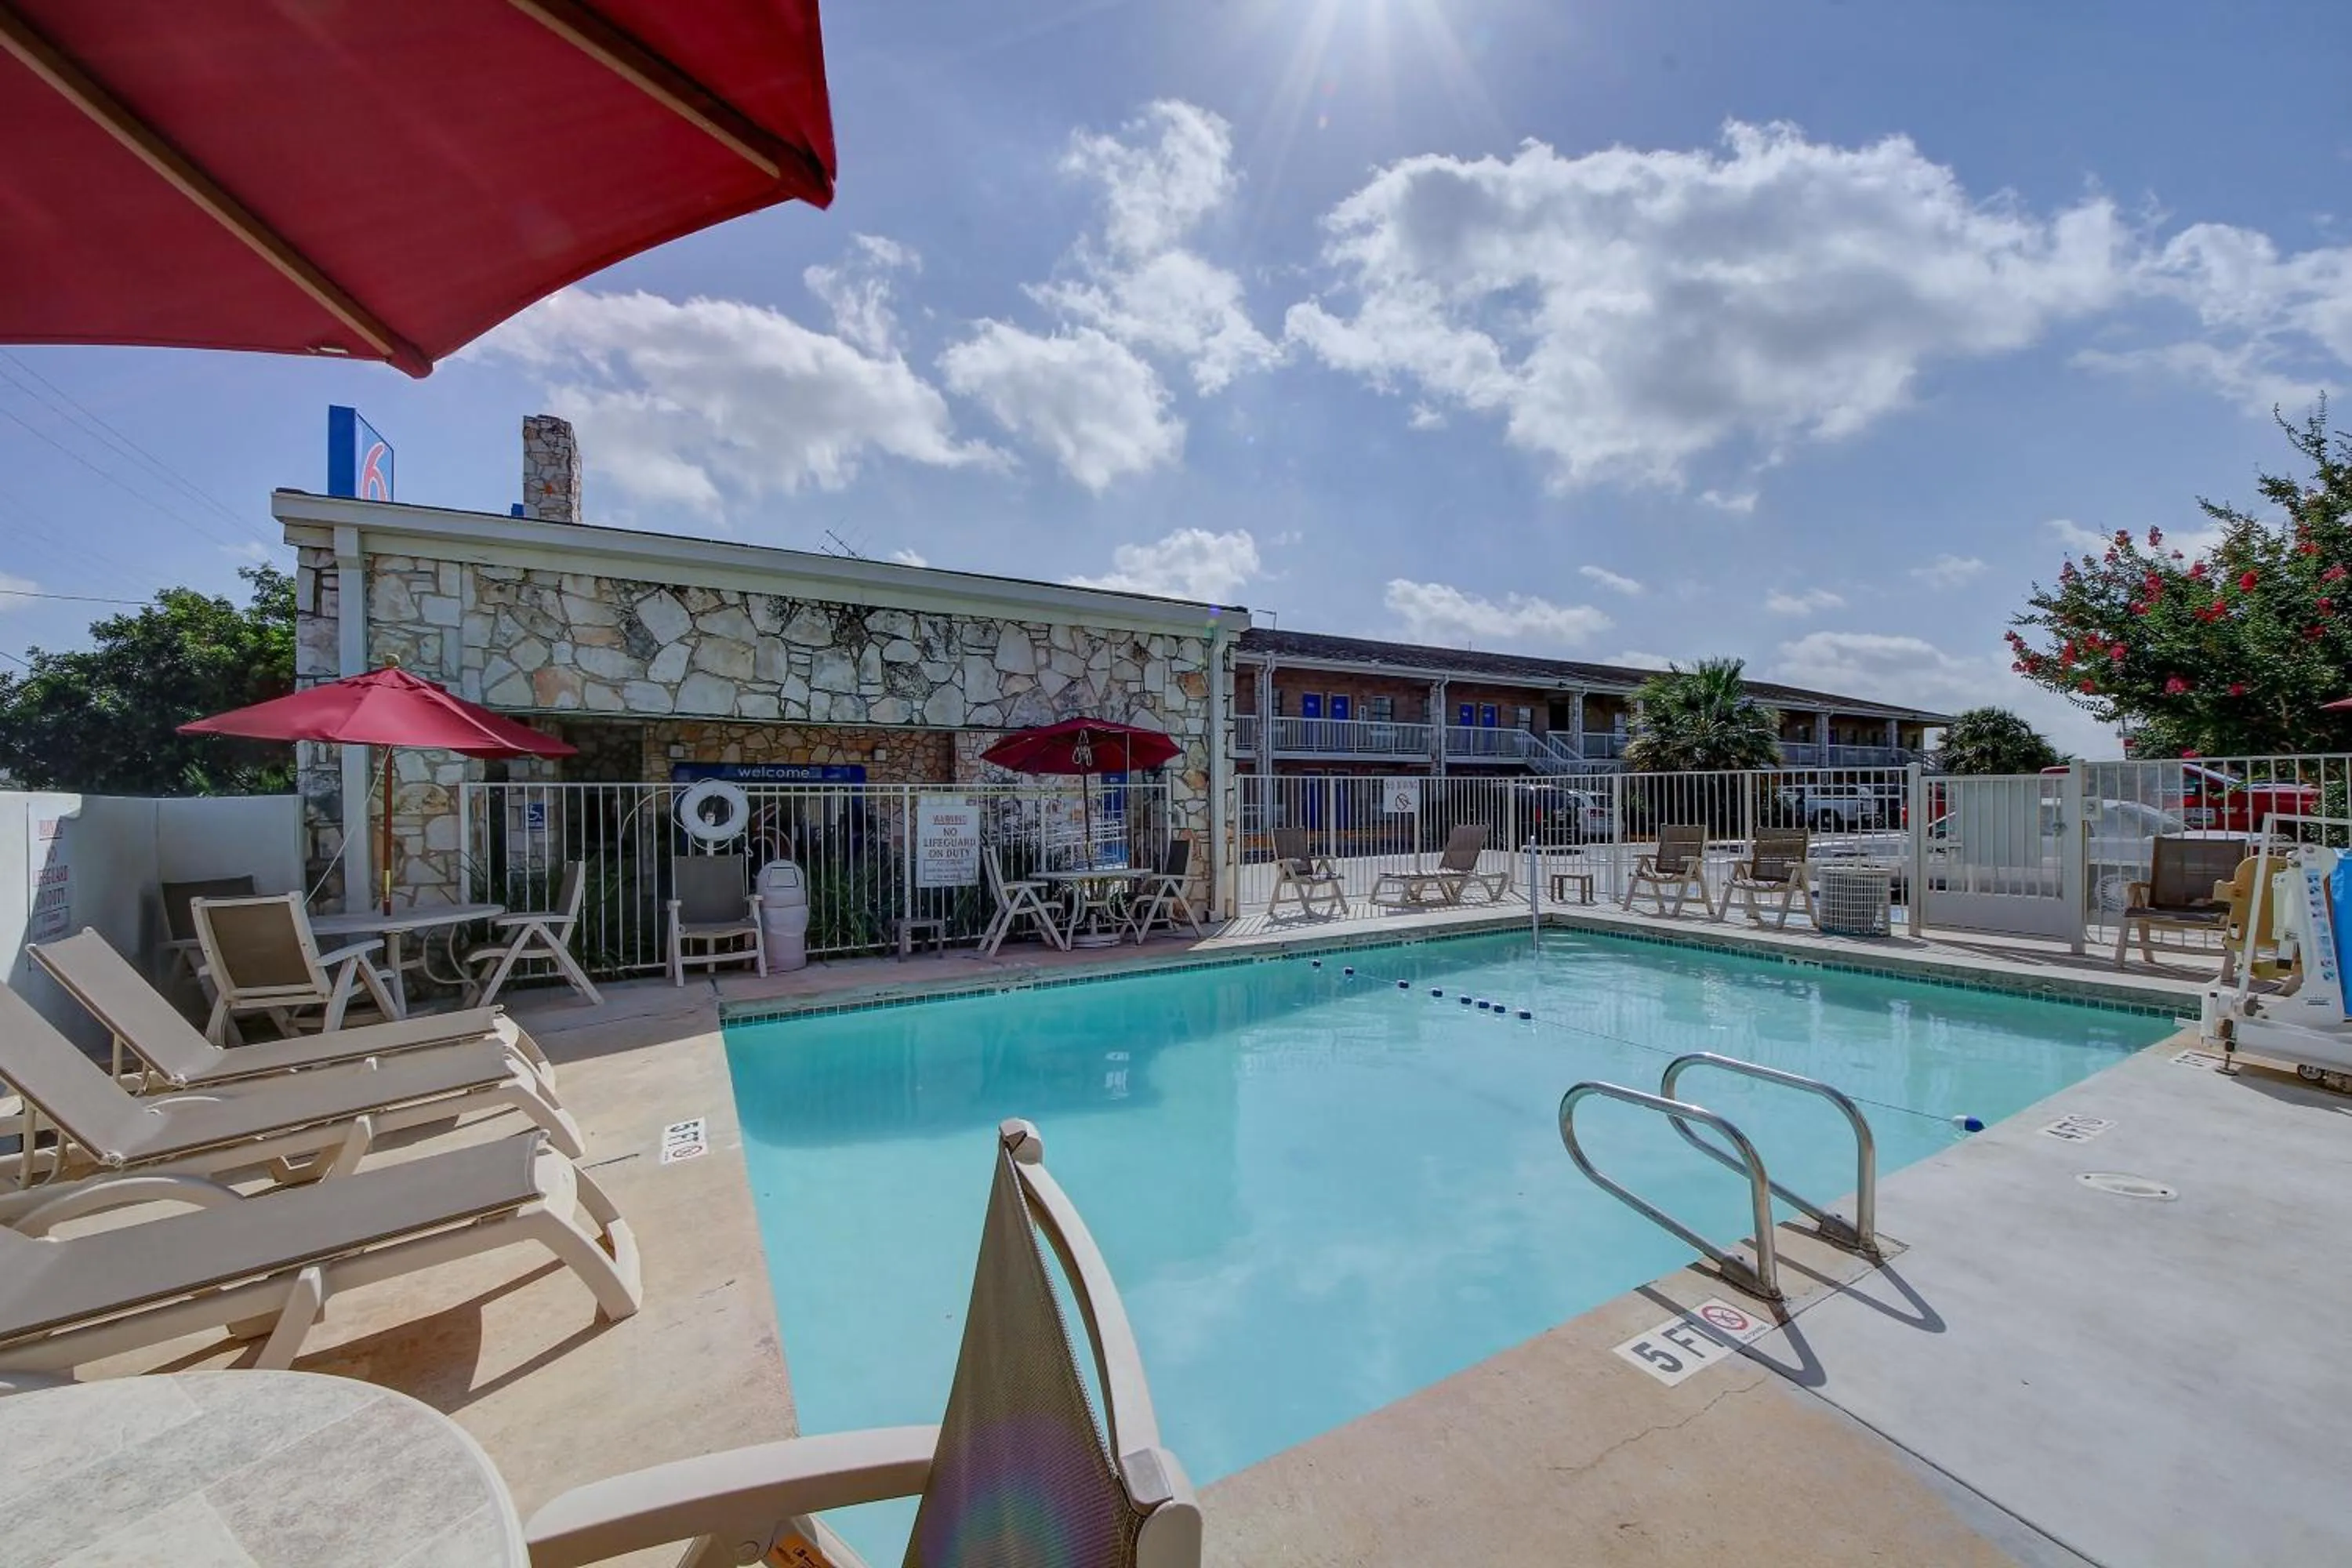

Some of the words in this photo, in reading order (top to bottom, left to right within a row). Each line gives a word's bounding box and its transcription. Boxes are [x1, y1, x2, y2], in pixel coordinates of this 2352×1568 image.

[738, 766, 810, 779] welcome
[943, 827, 957, 837] NO
[927, 848, 943, 858] ON
[946, 848, 970, 858] DUTY
[668, 1131, 699, 1147] FT
[1631, 1341, 1683, 1373] 5
[1661, 1319, 1726, 1359] FT
